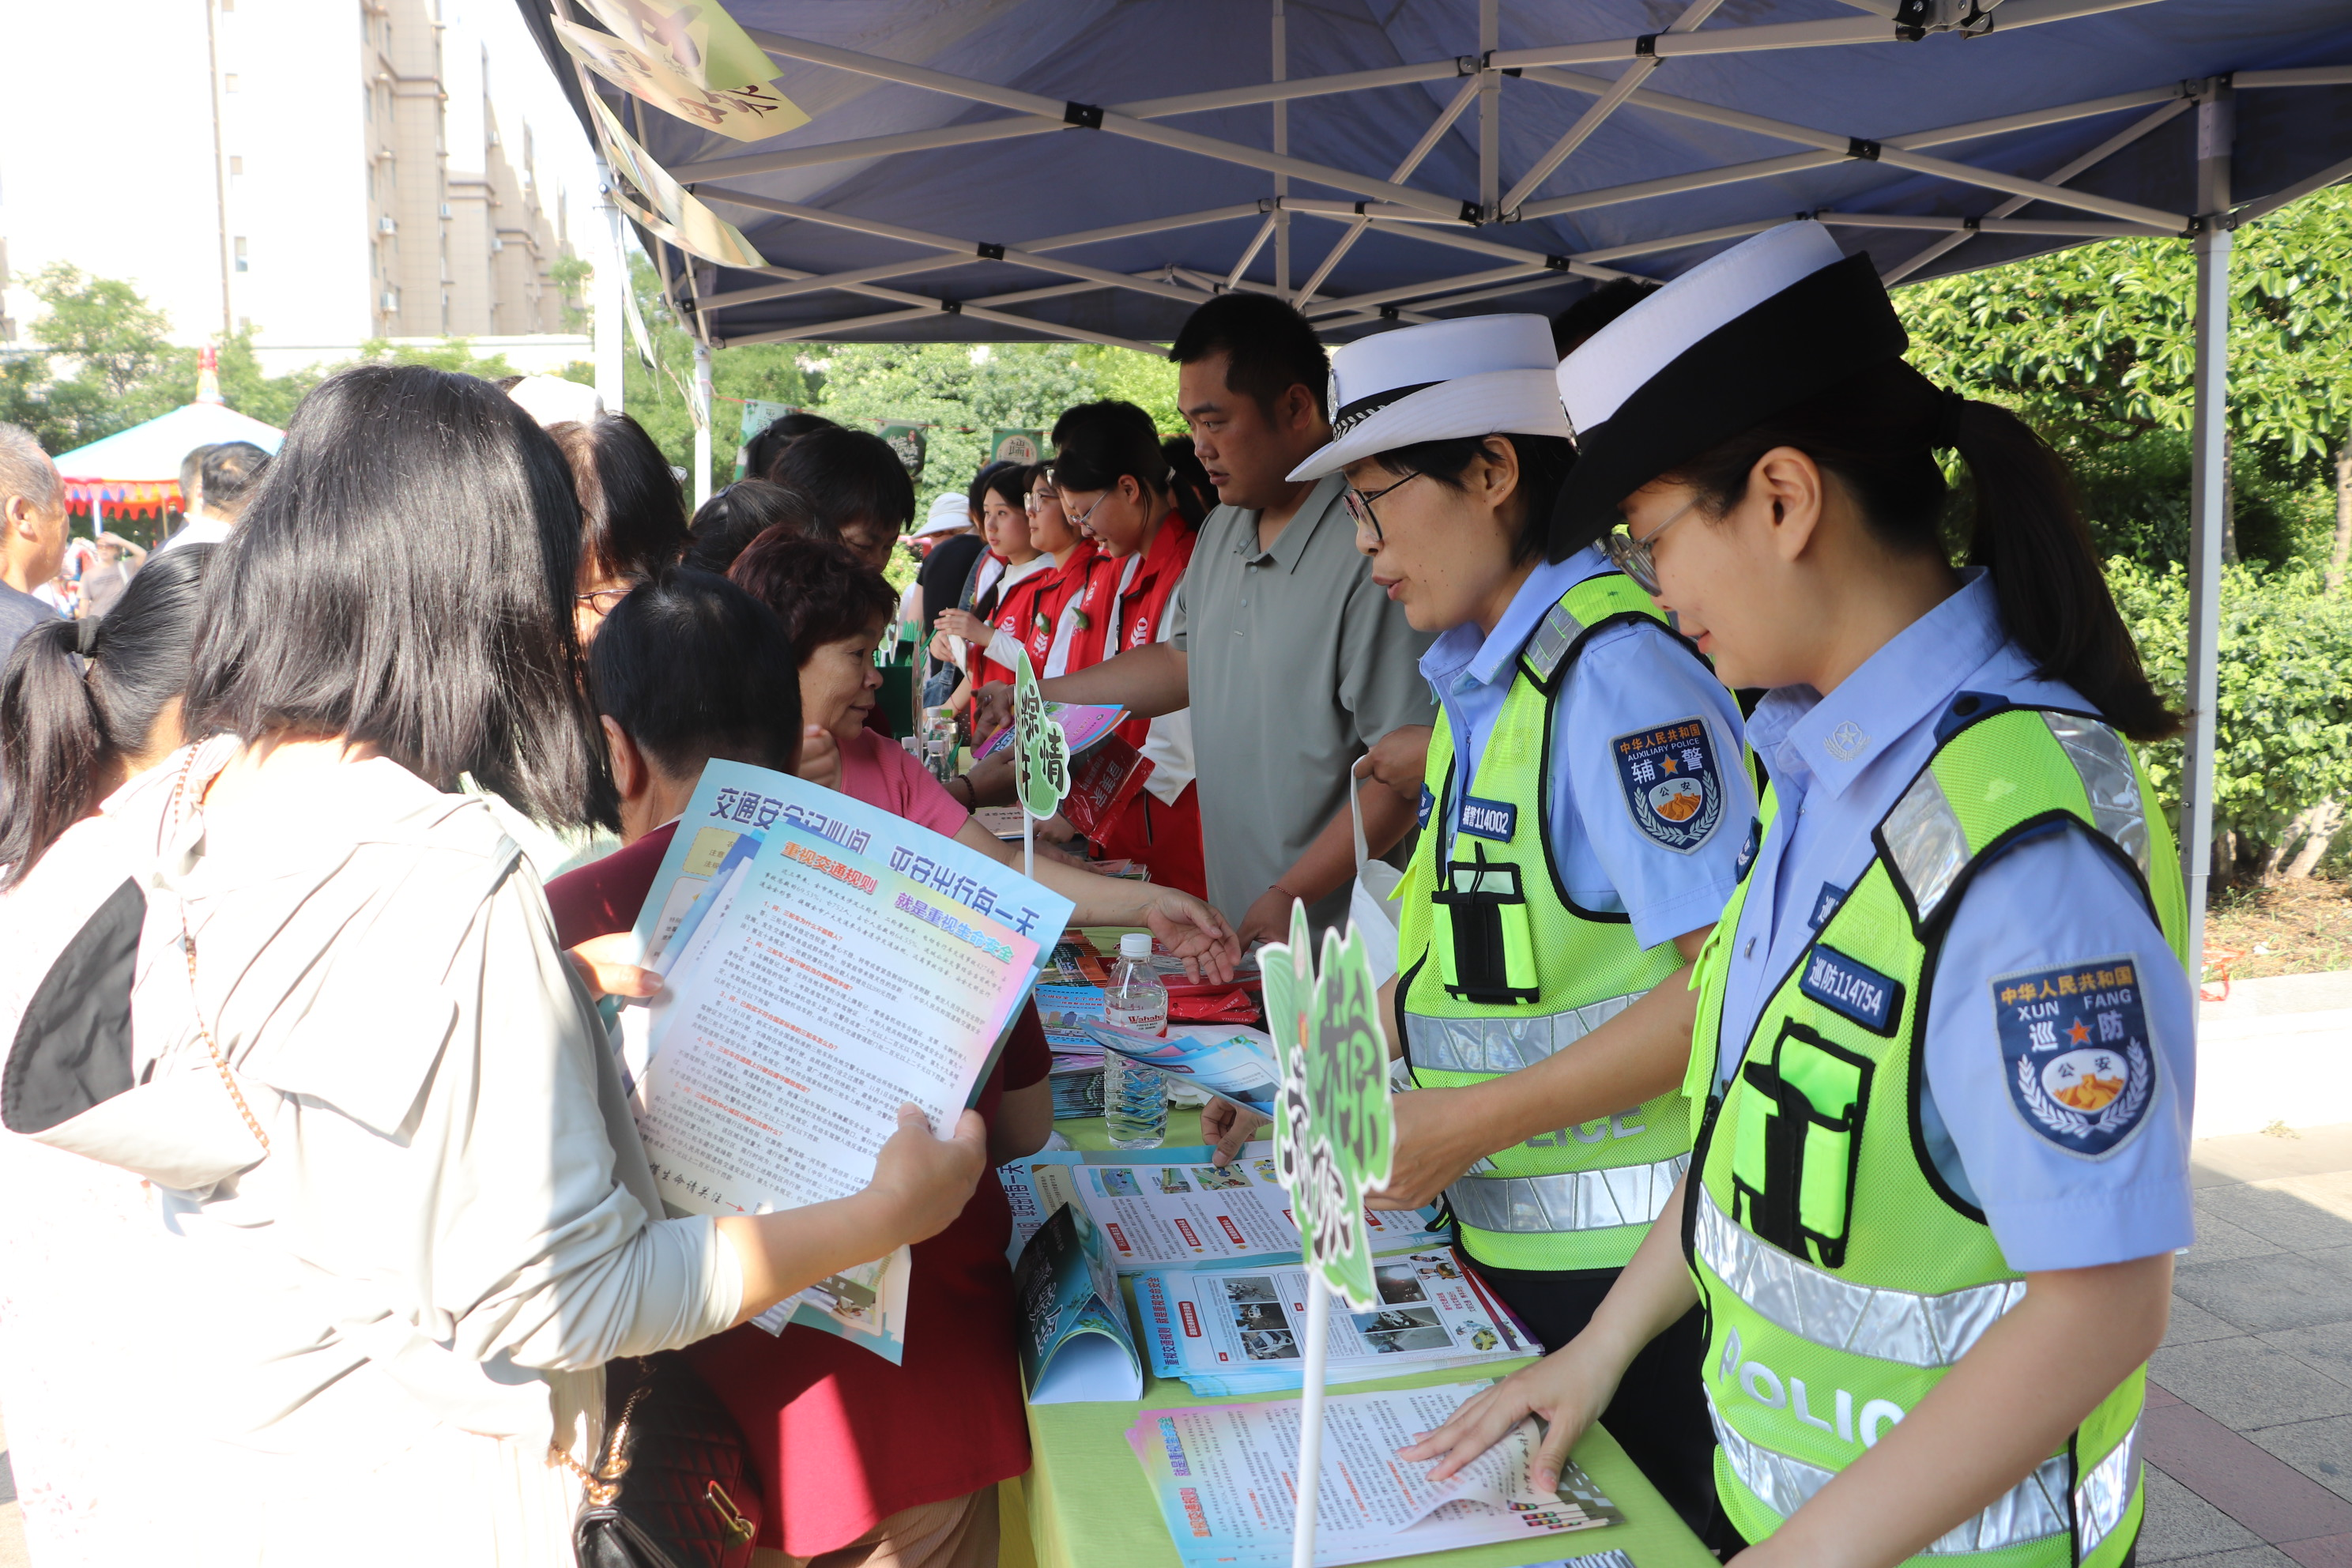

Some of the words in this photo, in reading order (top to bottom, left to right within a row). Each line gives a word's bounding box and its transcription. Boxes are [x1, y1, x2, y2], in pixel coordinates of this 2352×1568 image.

[1619, 723, 1701, 756] 中华人民共和国
[1627, 744, 1668, 763] AUXILIARY
[1671, 737, 1700, 752] POLICE
[1630, 761, 1657, 785] 辅
[1681, 747, 1703, 771] 警
[1461, 804, 1510, 835] 辅警114002
[779, 839, 879, 894] 重视交通规则
[893, 890, 1016, 963] 就是重视生命安全
[1807, 956, 1883, 1017] 巡防114754
[2000, 966, 2134, 1007] 中华人民共和国
[2016, 1000, 2060, 1023] XUN
[2083, 987, 2132, 1009] FANG
[1128, 1014, 1165, 1024] Wahaha
[2029, 1023, 2057, 1054] 巡
[2098, 1010, 2126, 1041] 防
[2056, 1059, 2075, 1080] 公
[2093, 1055, 2113, 1074] 安
[1718, 1326, 1905, 1449] POLIC
[1158, 1416, 1189, 1478] 就是重视生命安全
[1182, 1486, 1212, 1538] 重视交通规则
